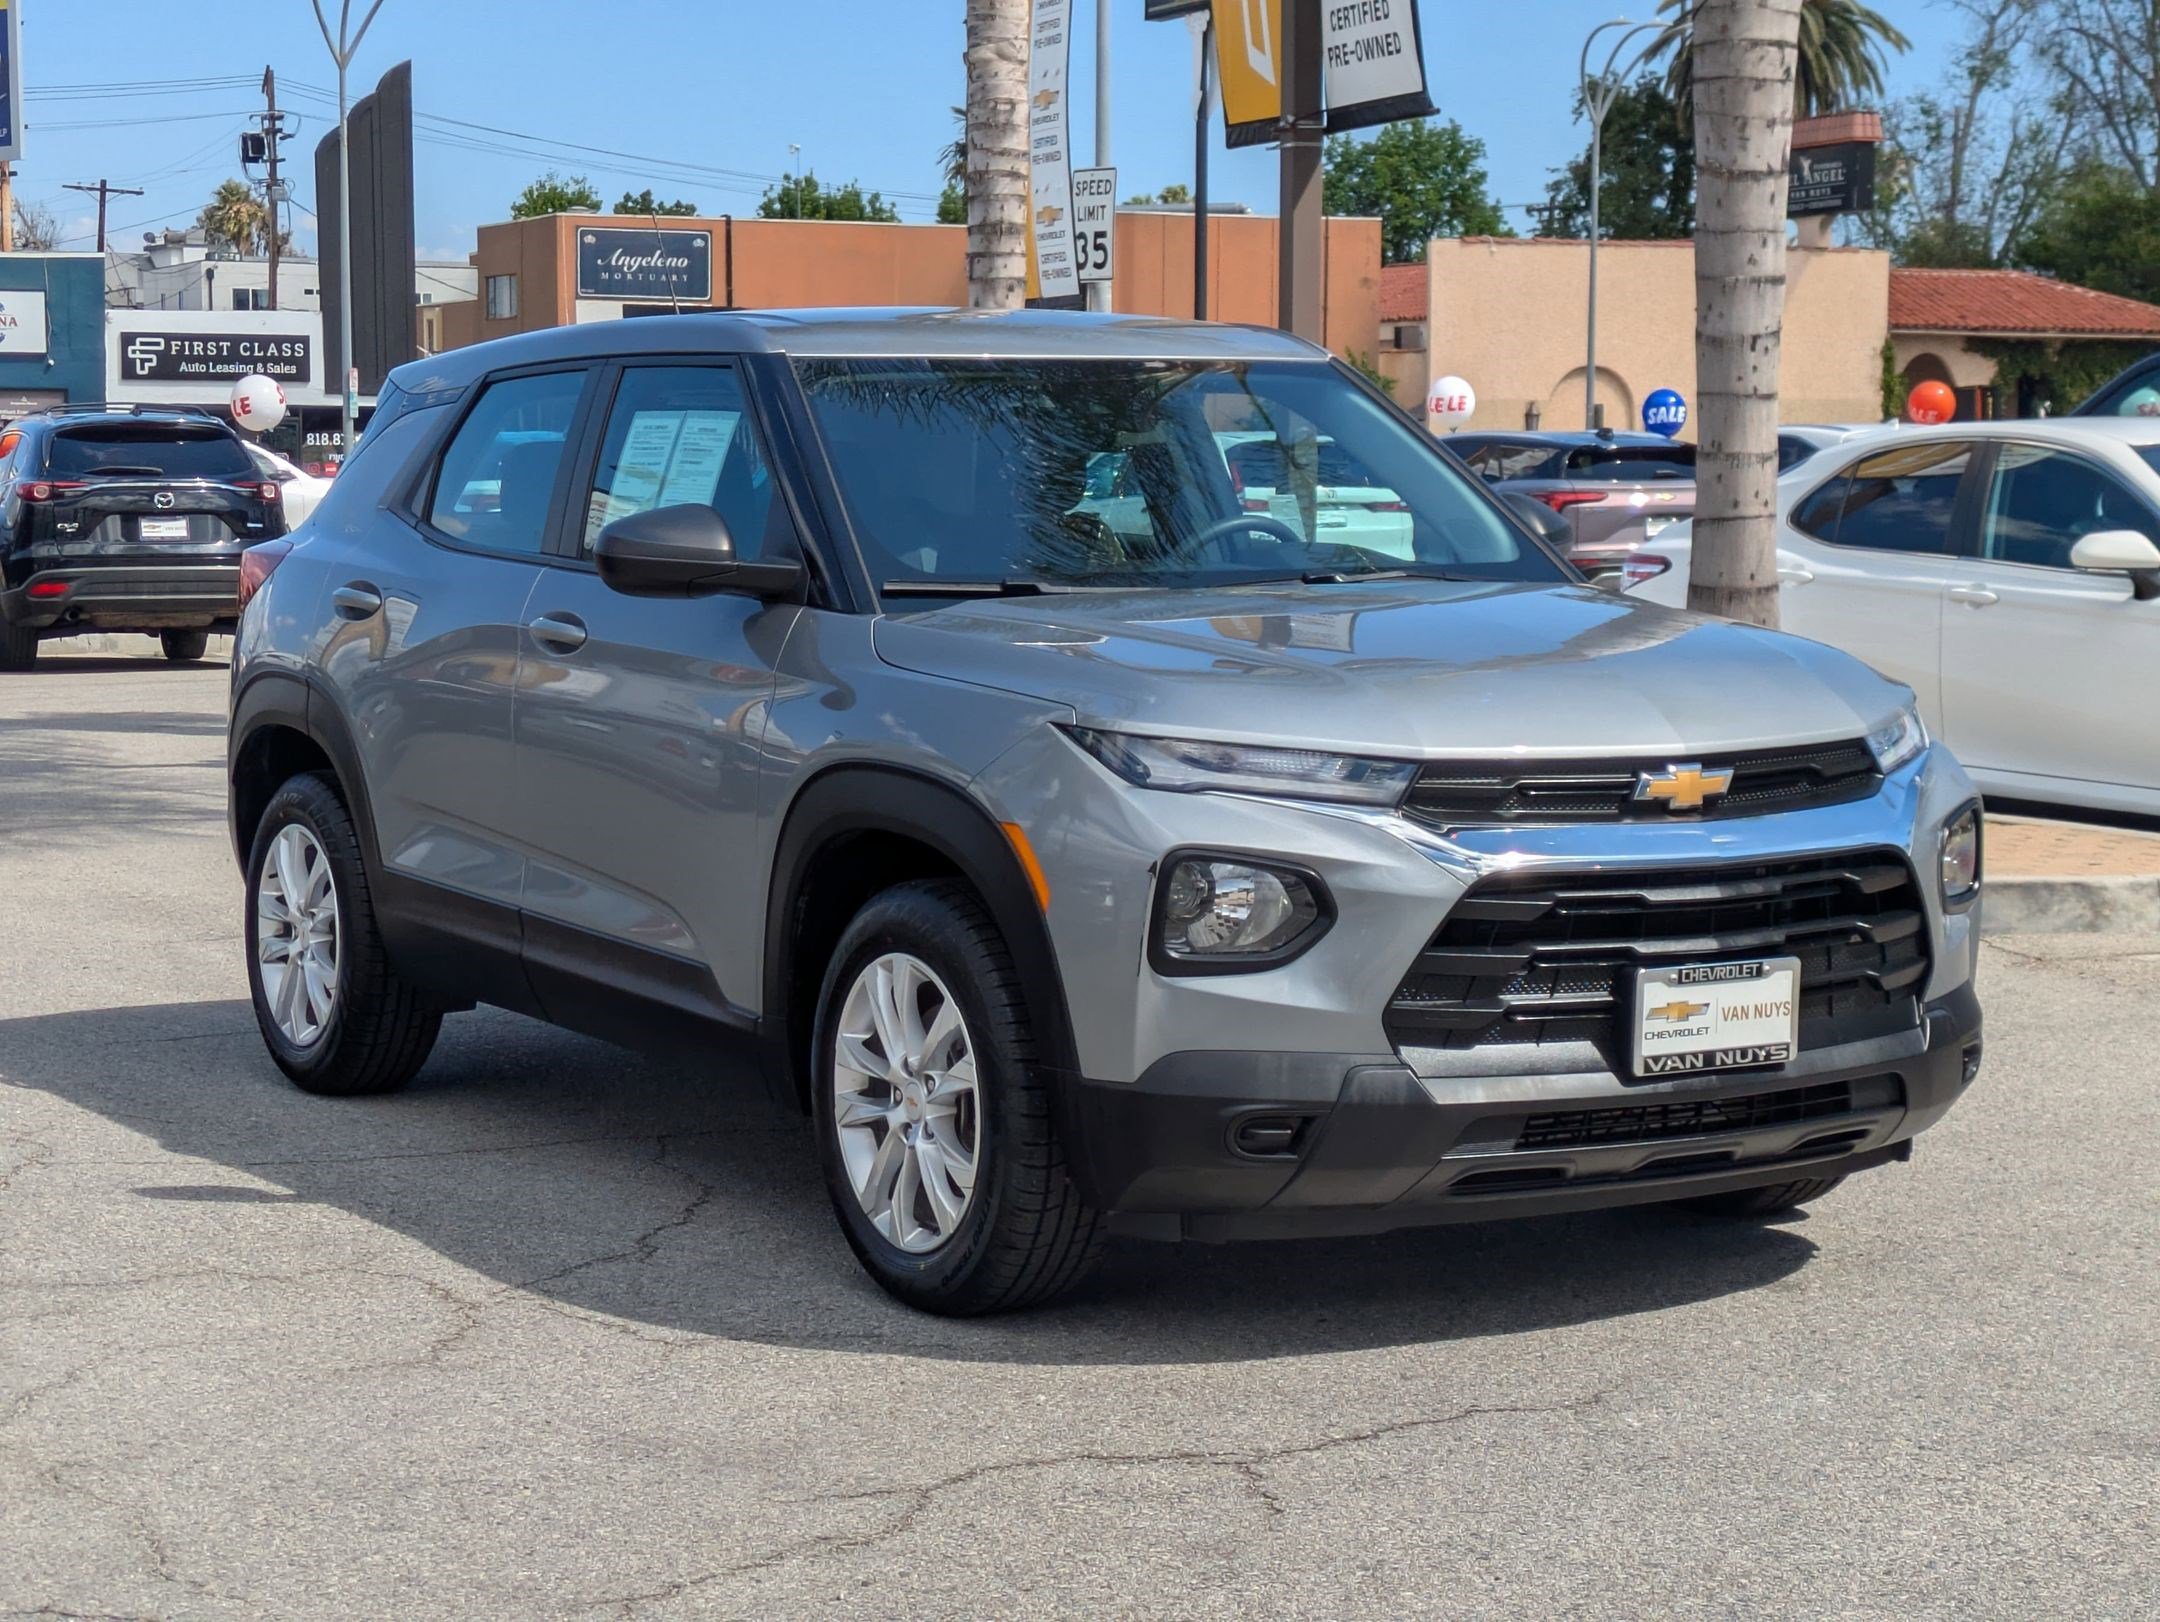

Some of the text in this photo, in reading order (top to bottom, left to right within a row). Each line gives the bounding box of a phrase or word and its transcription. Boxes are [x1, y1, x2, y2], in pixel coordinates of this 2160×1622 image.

[1330, 0, 1390, 32] CERTIFIED
[1327, 32, 1402, 69] PRE-OWNED
[1075, 179, 1112, 197] SPEED
[1077, 205, 1107, 222] LIMIT
[597, 248, 688, 272] Angeleno
[1076, 231, 1108, 271] 35
[601, 272, 688, 282] MORTUARY
[170, 341, 304, 357] FIRST CLASS
[179, 361, 297, 376] Auto Leasing & Sales
[1647, 405, 1686, 425] SALE
[1681, 963, 1760, 983] CHEVROLET
[1721, 1001, 1791, 1022] VAN NUYS
[1644, 1026, 1711, 1041] CHEVROLET
[1646, 1044, 1788, 1072] VAN NUYS
